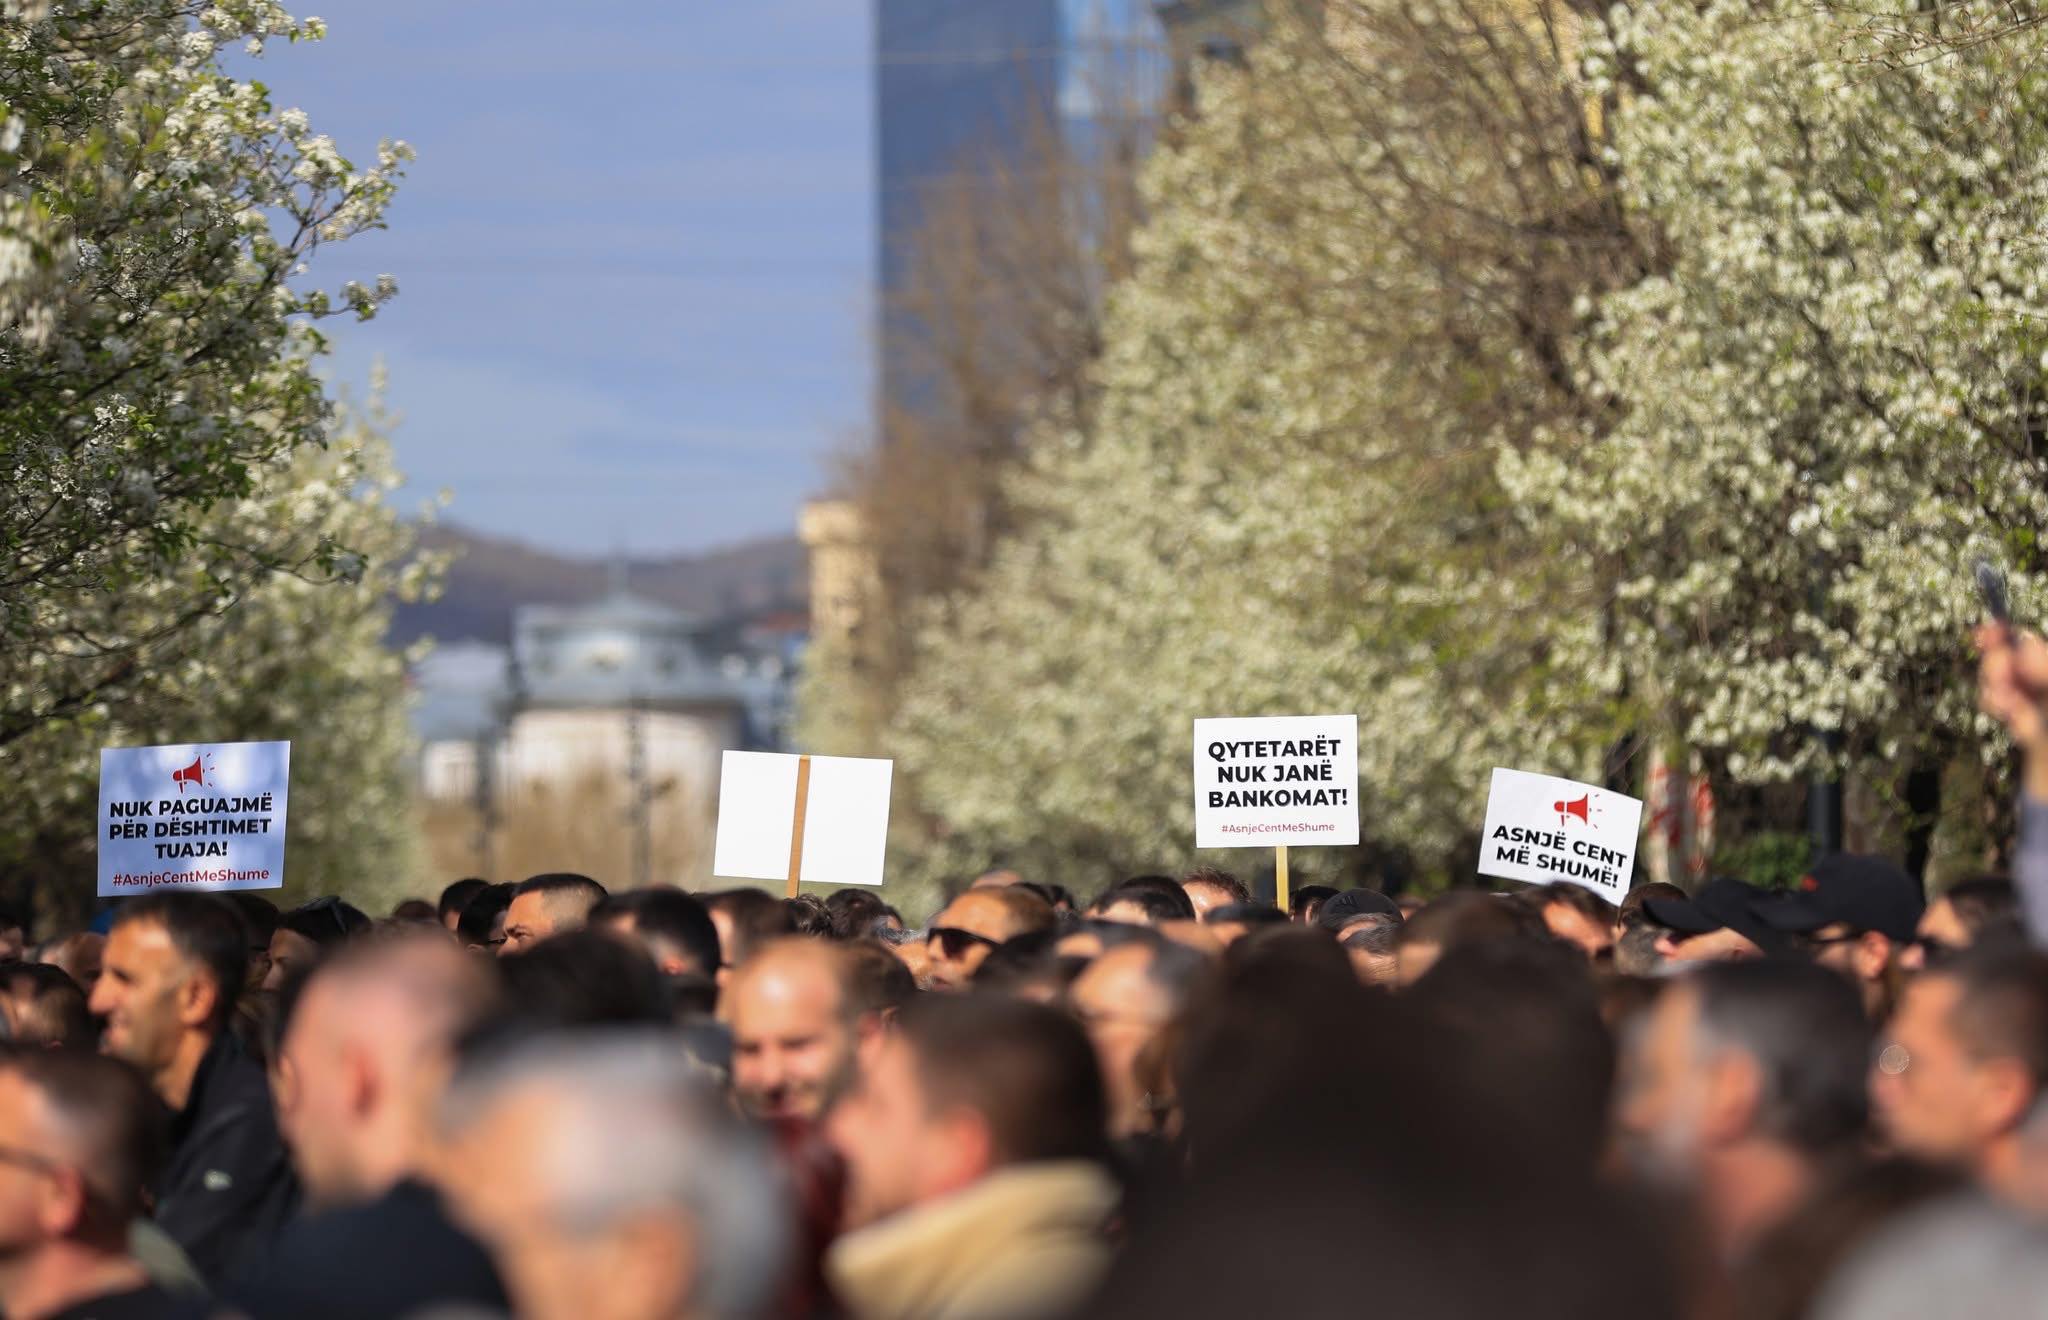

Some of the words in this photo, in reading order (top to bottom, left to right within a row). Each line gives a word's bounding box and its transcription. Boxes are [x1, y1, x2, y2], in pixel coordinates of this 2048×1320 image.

[1208, 734, 1341, 762] QYTETARËT
[1218, 765, 1266, 783] NUK
[1273, 759, 1333, 782] JANË
[110, 800, 153, 818] NUK
[158, 792, 272, 815] PAGUAJMË
[1208, 788, 1348, 808] BANKOMAT!
[109, 820, 148, 840] PËR
[154, 817, 272, 837] DËSHTIMET
[1221, 823, 1335, 835] #AsnjeCentMeShume
[154, 841, 228, 860] TUAJA!
[1492, 825, 1566, 851] ASNJË
[1573, 840, 1627, 868] CENT
[112, 868, 270, 888] #AsnjeCentMeShume
[1496, 845, 1530, 866] MË
[1536, 853, 1618, 888] SHUMË!
